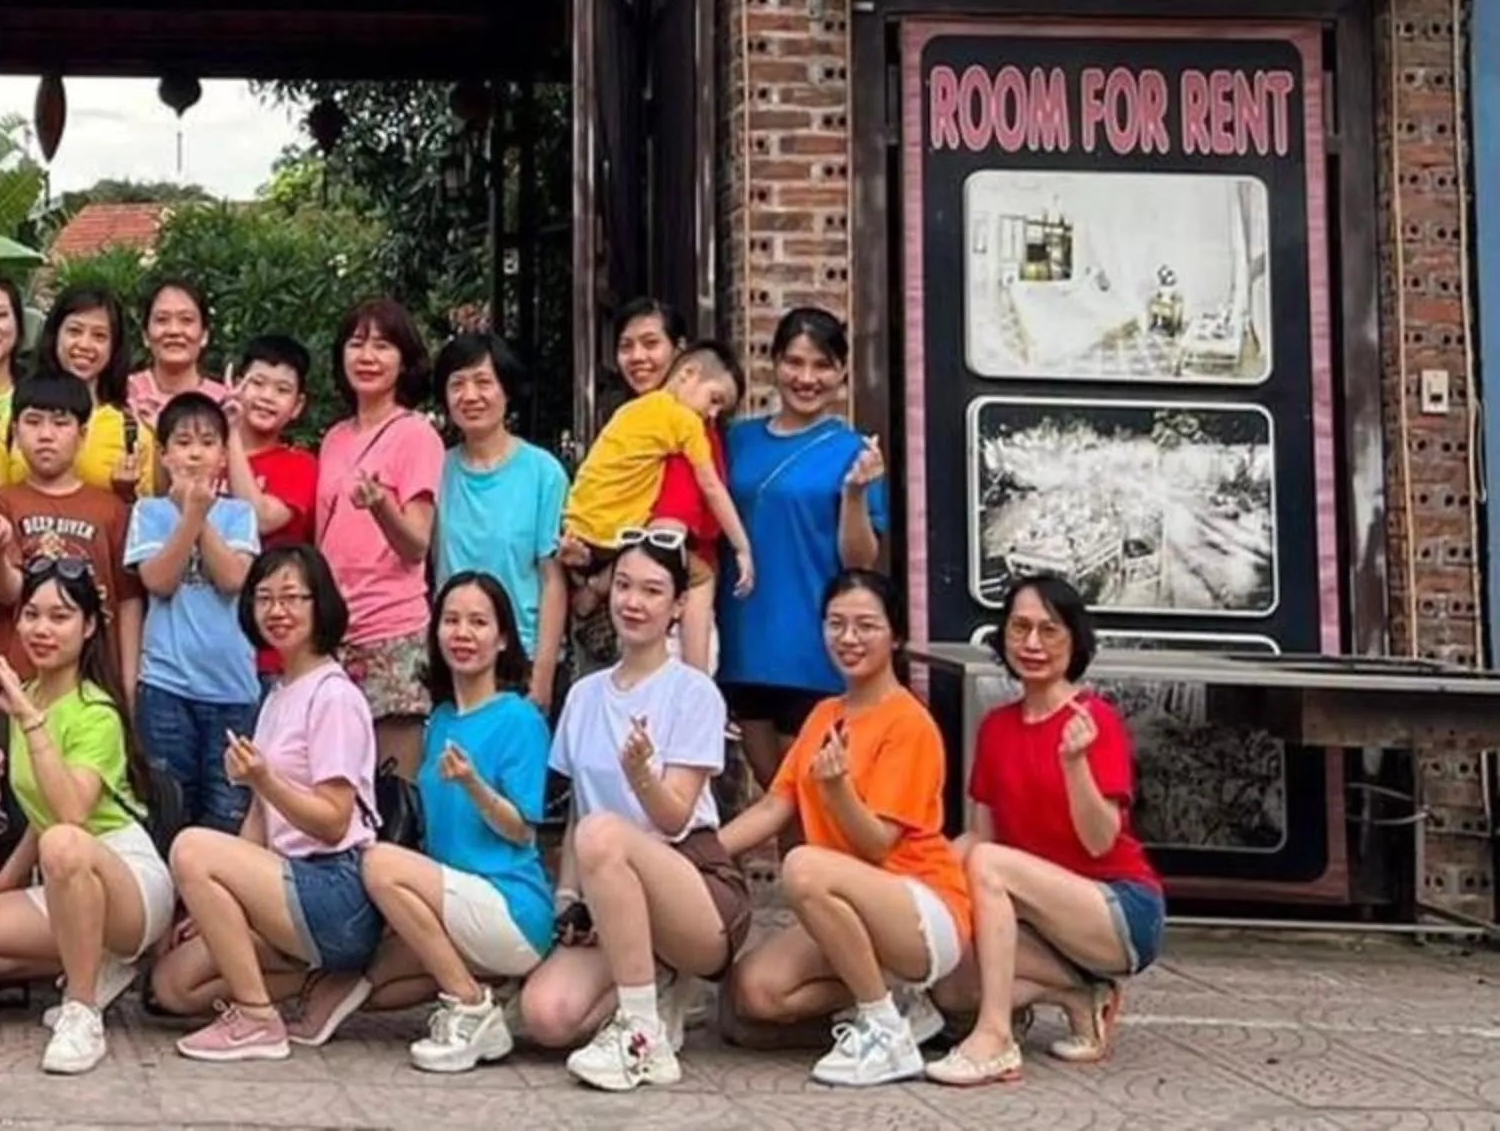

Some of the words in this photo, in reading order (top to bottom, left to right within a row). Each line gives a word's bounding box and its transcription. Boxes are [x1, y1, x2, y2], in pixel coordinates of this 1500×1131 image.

[929, 63, 1071, 153] ROOM
[1080, 65, 1170, 156] FOR
[1180, 69, 1295, 157] RENT
